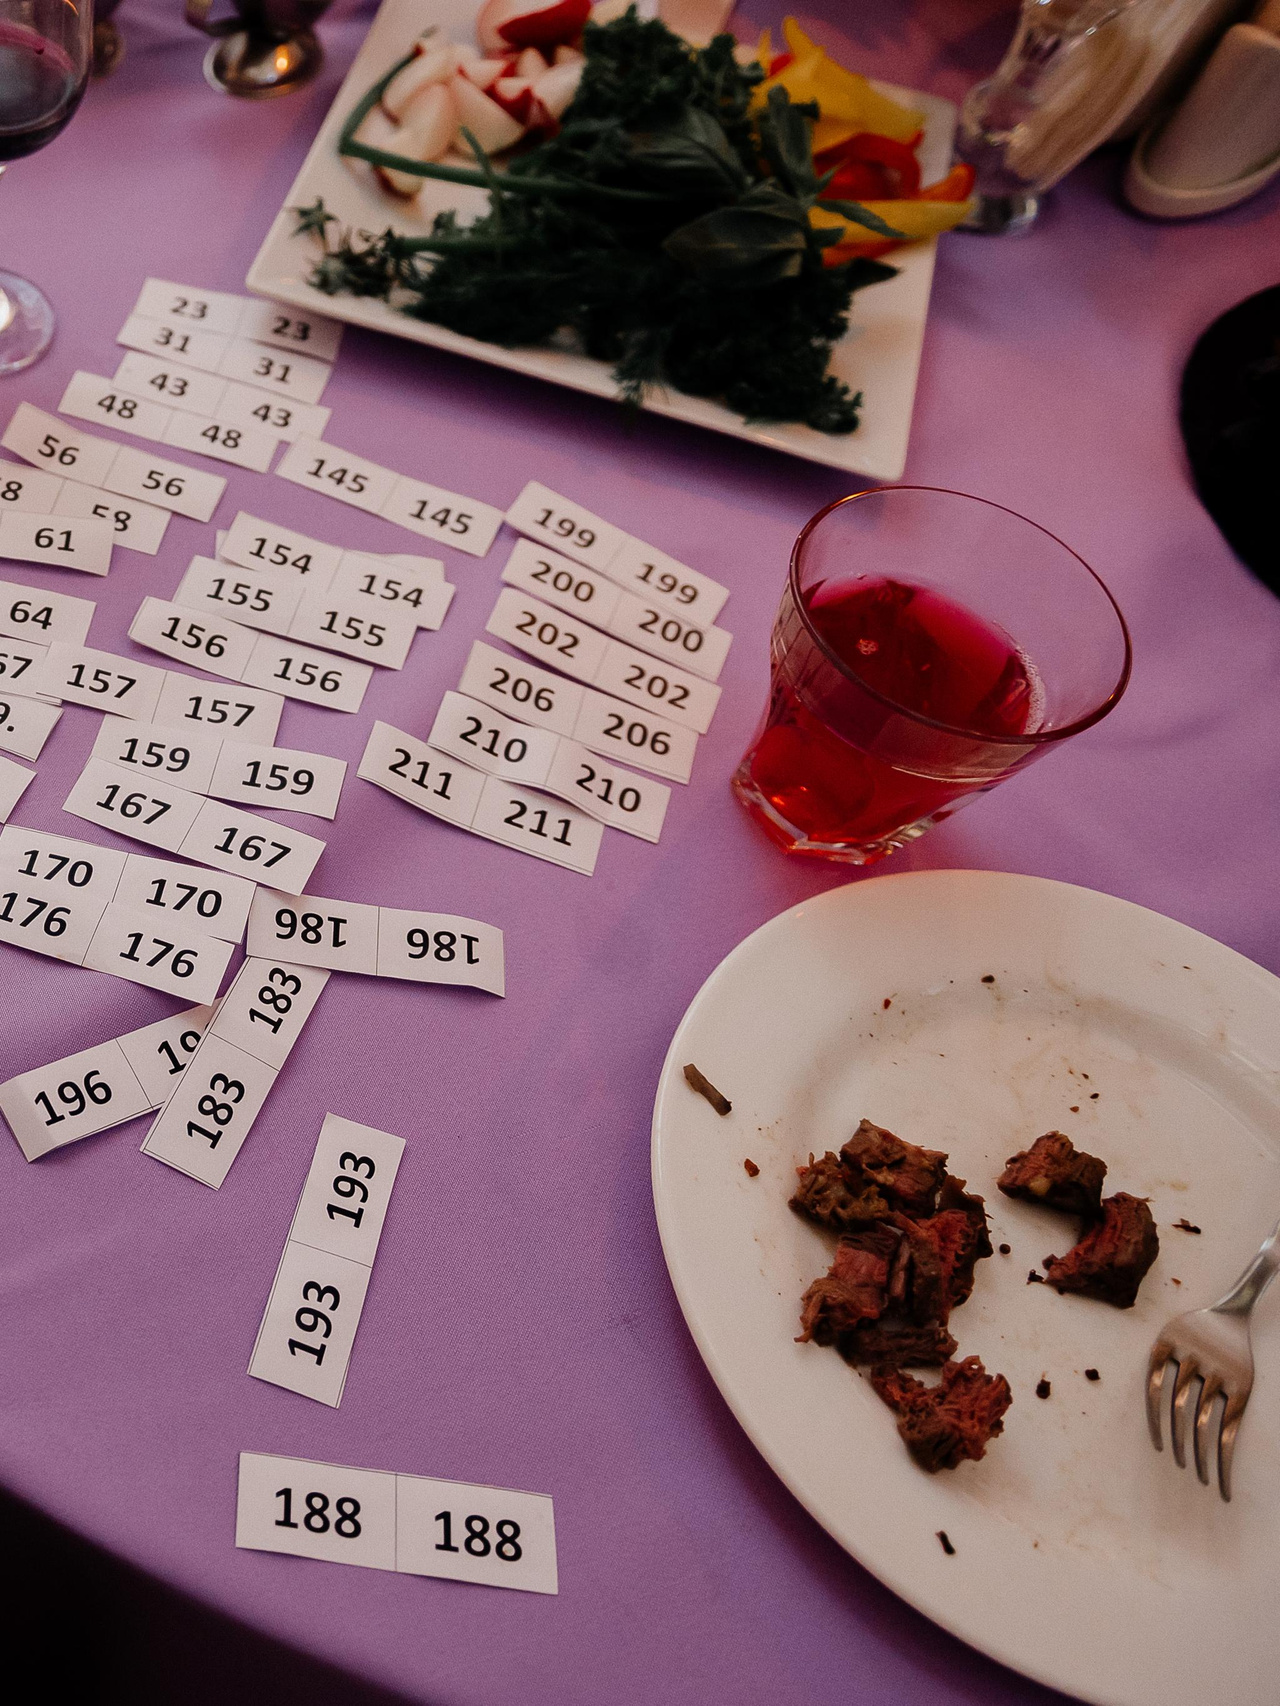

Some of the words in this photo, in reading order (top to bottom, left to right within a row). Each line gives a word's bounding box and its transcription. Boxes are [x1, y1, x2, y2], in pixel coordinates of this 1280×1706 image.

[171, 297, 208, 320] 23
[272, 315, 311, 341] 23
[154, 327, 190, 352] 31
[253, 356, 291, 383] 31
[97, 394, 138, 420] 48
[201, 424, 242, 449] 48
[149, 373, 189, 397] 43
[252, 404, 292, 428] 43
[37, 434, 79, 466] 56
[142, 469, 185, 497] 56
[308, 458, 368, 494] 145
[410, 500, 473, 535] 145
[34, 527, 75, 553] 61
[249, 537, 312, 575] 154
[359, 574, 424, 608] 154
[536, 508, 596, 549] 199
[637, 563, 699, 605] 199
[9, 600, 53, 630] 64
[206, 578, 273, 612] 155
[320, 611, 386, 647] 155
[530, 560, 595, 603] 200
[638, 609, 704, 653] 200
[161, 617, 228, 658] 156
[273, 657, 342, 693] 156
[515, 610, 580, 658] 202
[623, 664, 690, 710] 202
[66, 663, 137, 699] 157
[184, 696, 255, 727] 157
[489, 667, 555, 712] 206
[602, 713, 671, 756] 206
[118, 738, 191, 773] 159
[241, 760, 315, 796] 159
[388, 747, 452, 801] 211
[503, 799, 572, 847] 211
[459, 716, 528, 763] 210
[575, 763, 642, 813] 210
[96, 784, 172, 825] 167
[214, 827, 292, 868] 167
[18, 849, 94, 888] 170
[145, 878, 223, 918] 170
[119, 932, 199, 978] 176
[275, 908, 348, 948] 186
[406, 928, 480, 965] 186
[34, 1069, 113, 1127] 196
[157, 1021, 210, 1075] 19
[186, 1072, 245, 1150] 183
[248, 967, 302, 1035] 183
[287, 1280, 341, 1367] 193
[326, 1151, 376, 1229] 193
[274, 1487, 362, 1539] 188
[434, 1510, 523, 1562] 188
